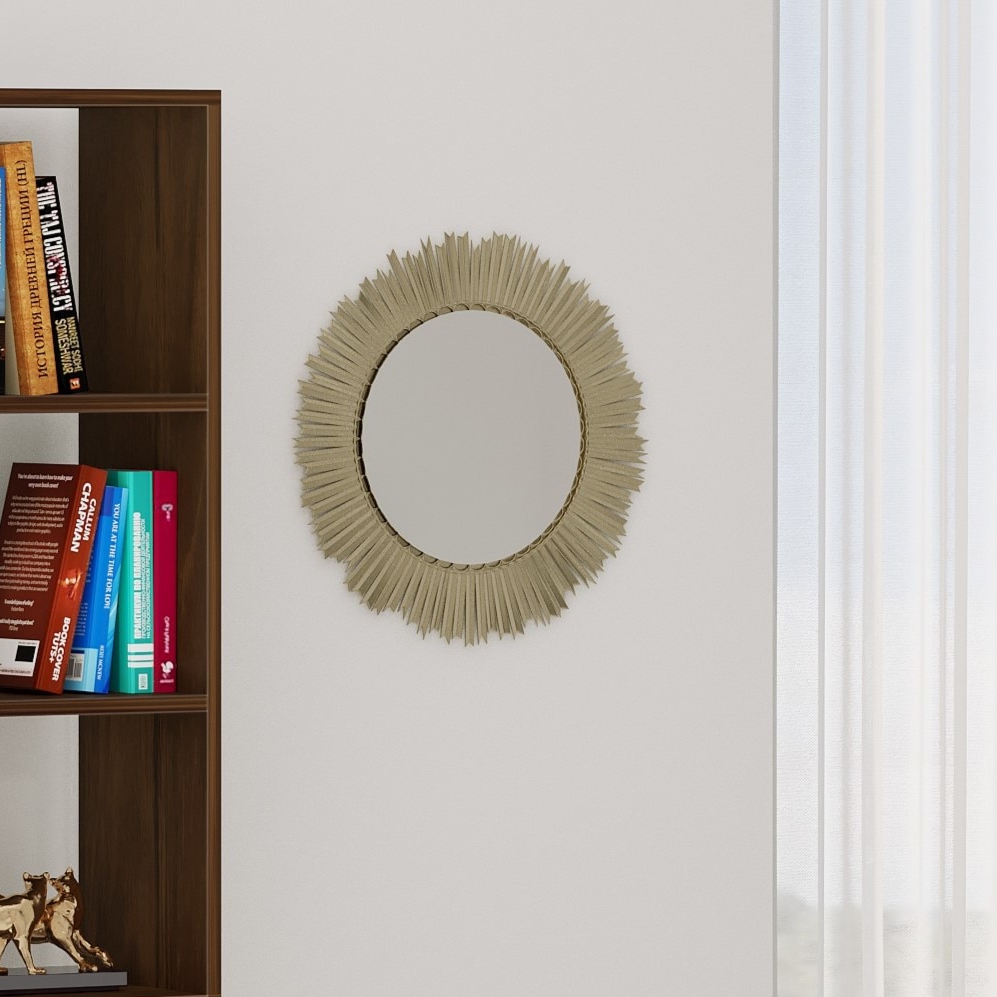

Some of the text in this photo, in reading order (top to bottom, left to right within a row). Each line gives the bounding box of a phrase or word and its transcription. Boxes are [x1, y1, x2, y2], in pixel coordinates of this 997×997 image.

[20, 190, 33, 242] ГРЕЦИИ
[36, 181, 56, 209] THE
[39, 212, 60, 235] TAJ
[25, 247, 42, 308] ДРЕВНЕЙ
[32, 312, 48, 378] ИСТОРИЯ
[54, 318, 72, 375] SOMESHWAR
[65, 316, 83, 372] MANREET SODHI
[70, 482, 92, 552] CHAPMAN
[82, 498, 97, 541] CALLUM
[113, 503, 121, 517] YOU
[109, 544, 117, 558] THE
[111, 534, 117, 543] AT
[107, 559, 115, 577] TIME
[133, 512, 141, 639] ПРАКТИКУМ ПО ПЛАНИРОВАНИЮ
[50, 632, 61, 663] TUTS+
[52, 617, 71, 681] BOOK COVER
